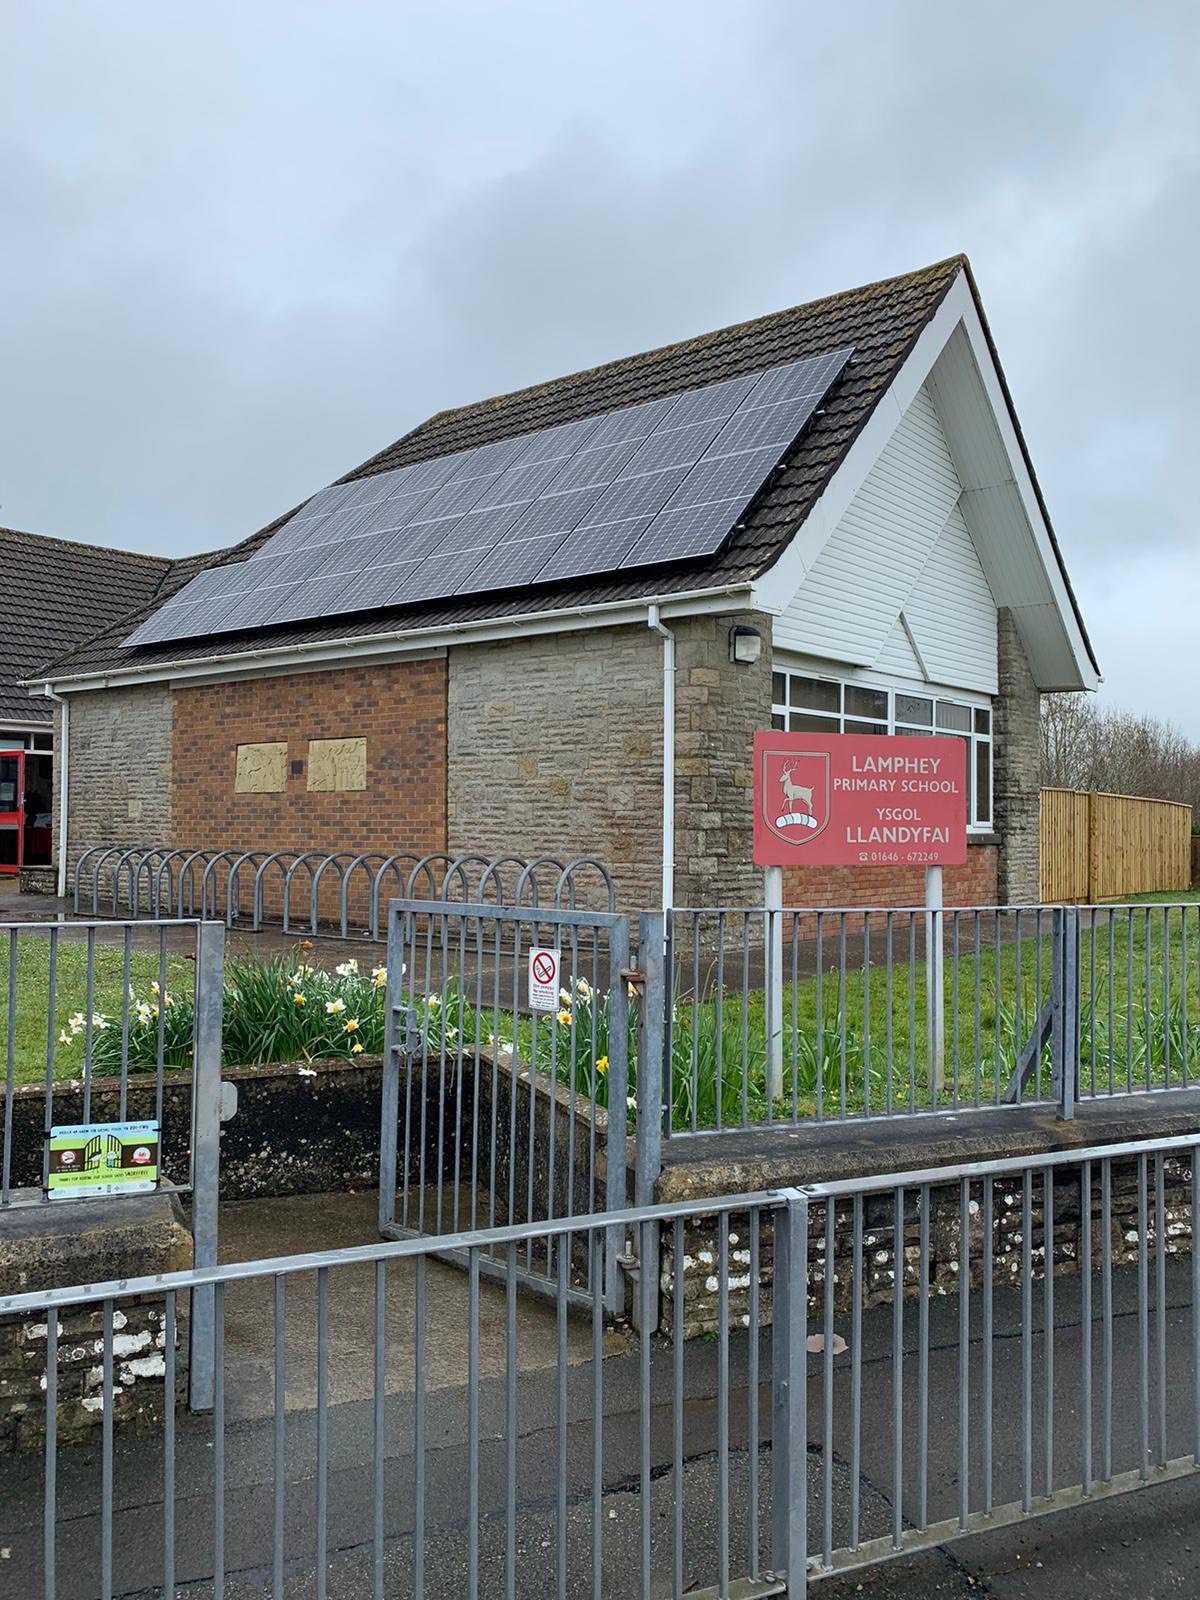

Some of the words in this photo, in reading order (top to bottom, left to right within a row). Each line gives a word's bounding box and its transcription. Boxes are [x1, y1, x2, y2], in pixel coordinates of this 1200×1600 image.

[852, 755, 942, 774] LAMPHEY
[833, 777, 897, 792] PRIMARY
[901, 779, 959, 793] SCHOOL
[876, 808, 921, 821] YSGOL
[846, 827, 949, 843] LLANDYFAI
[871, 852, 899, 862] 01646
[906, 852, 939, 862] 672249
